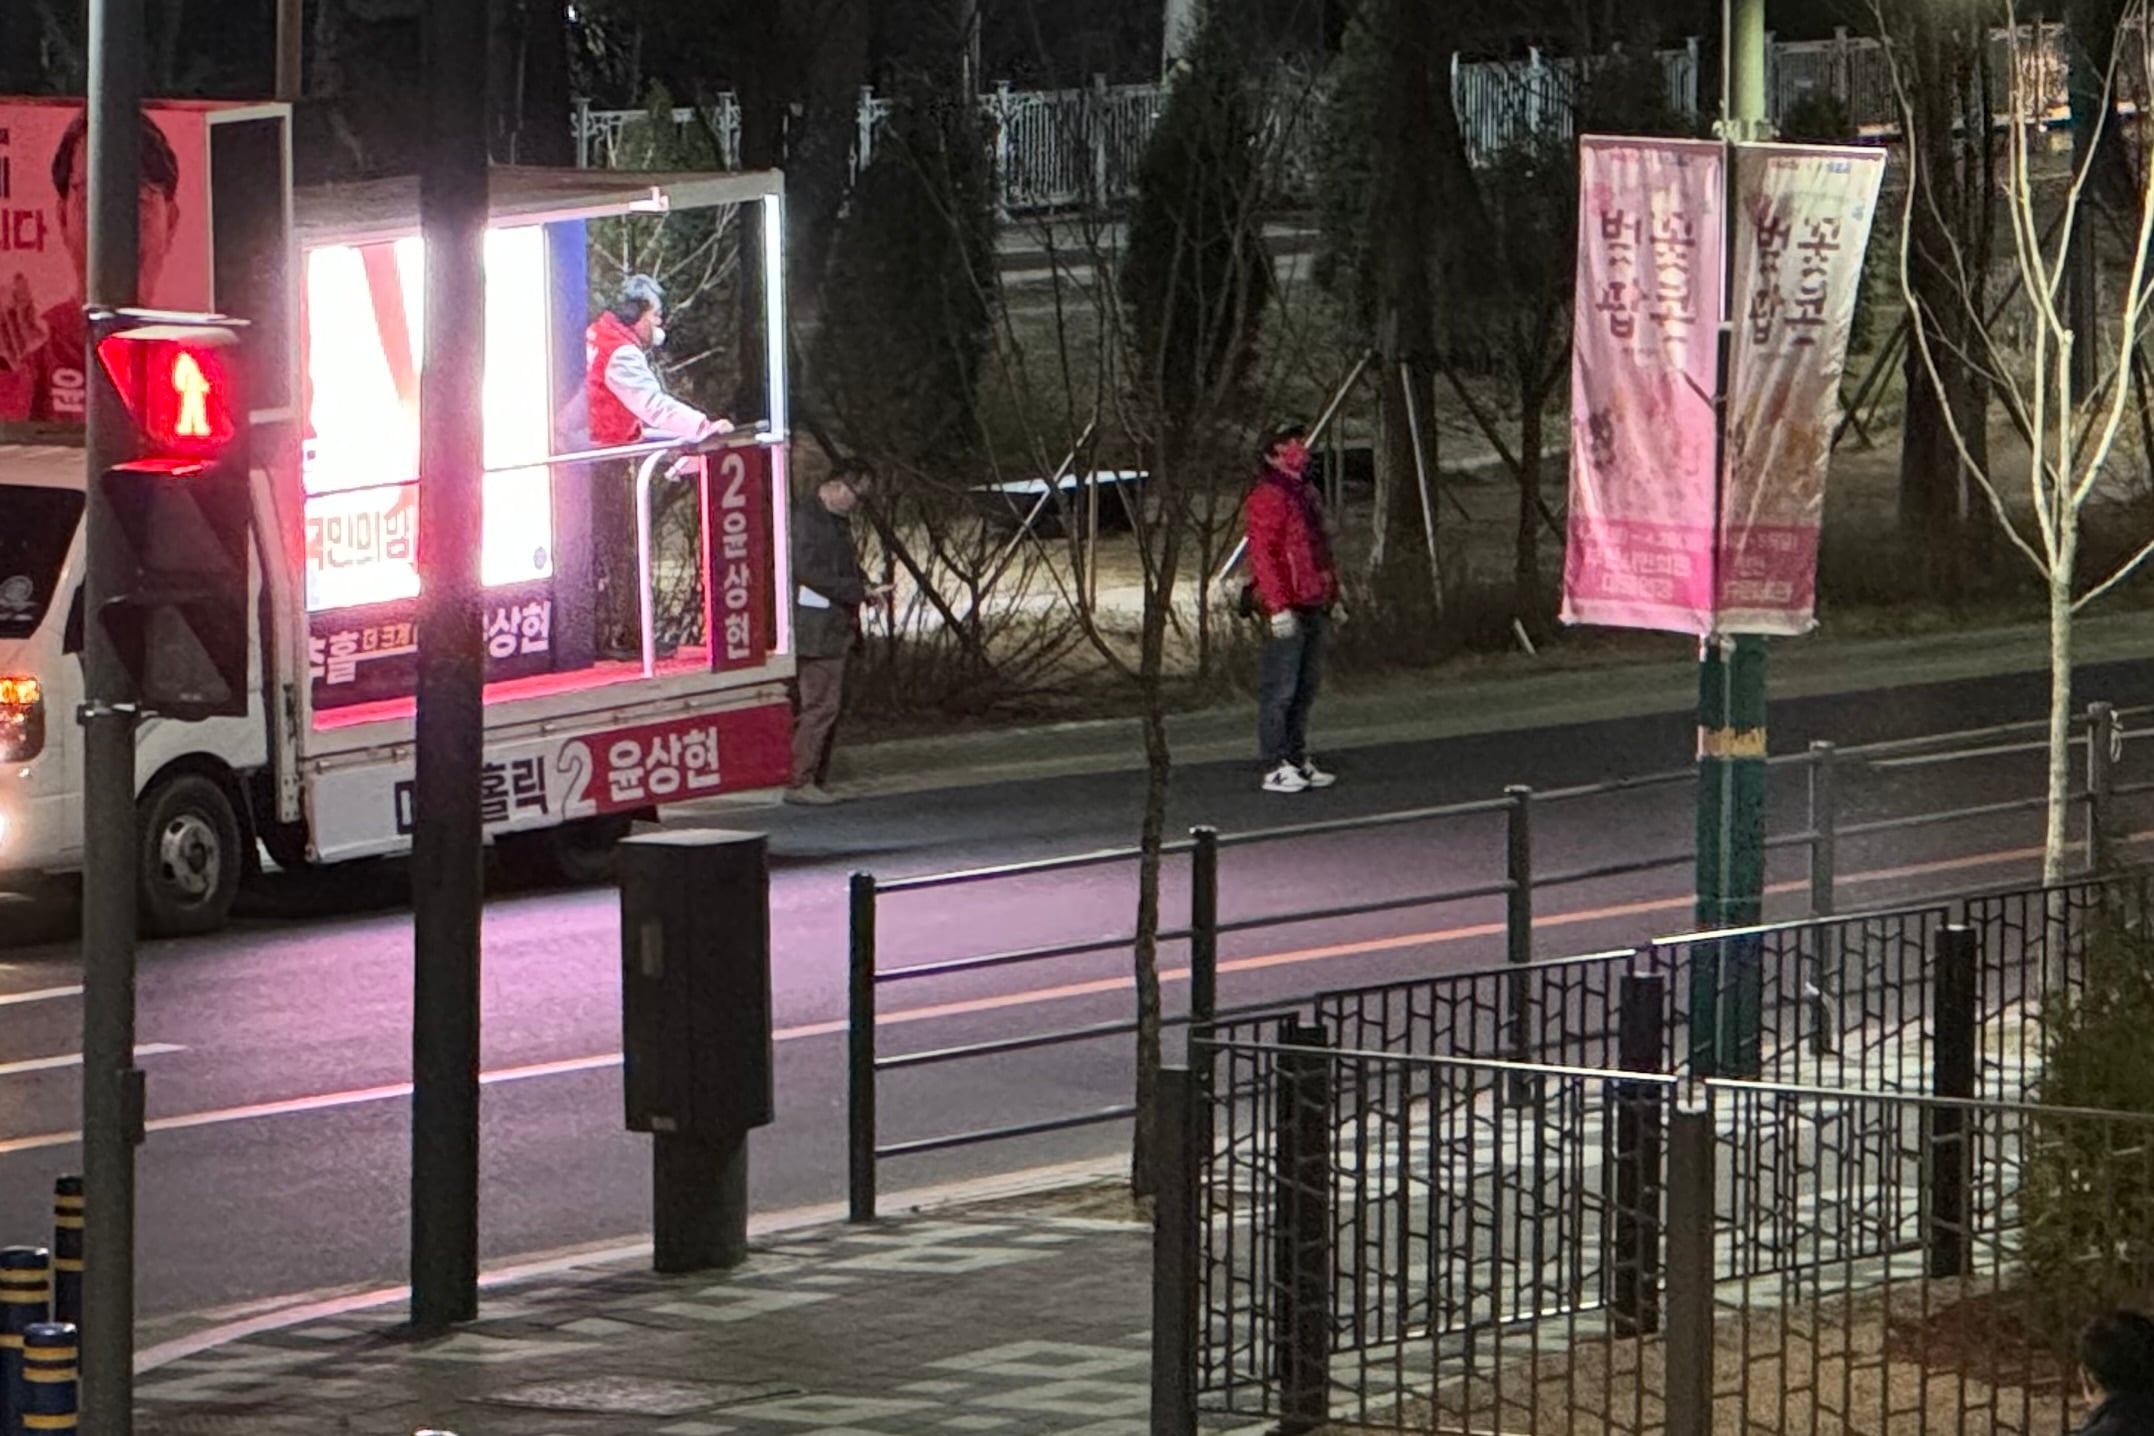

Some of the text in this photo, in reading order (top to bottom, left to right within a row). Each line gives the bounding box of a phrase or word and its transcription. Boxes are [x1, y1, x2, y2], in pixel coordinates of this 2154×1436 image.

[720, 453, 747, 509] 2
[722, 511, 751, 660] 윤상현
[482, 600, 552, 658] 상현
[557, 738, 598, 822] 2
[608, 726, 721, 803] 윤상현
